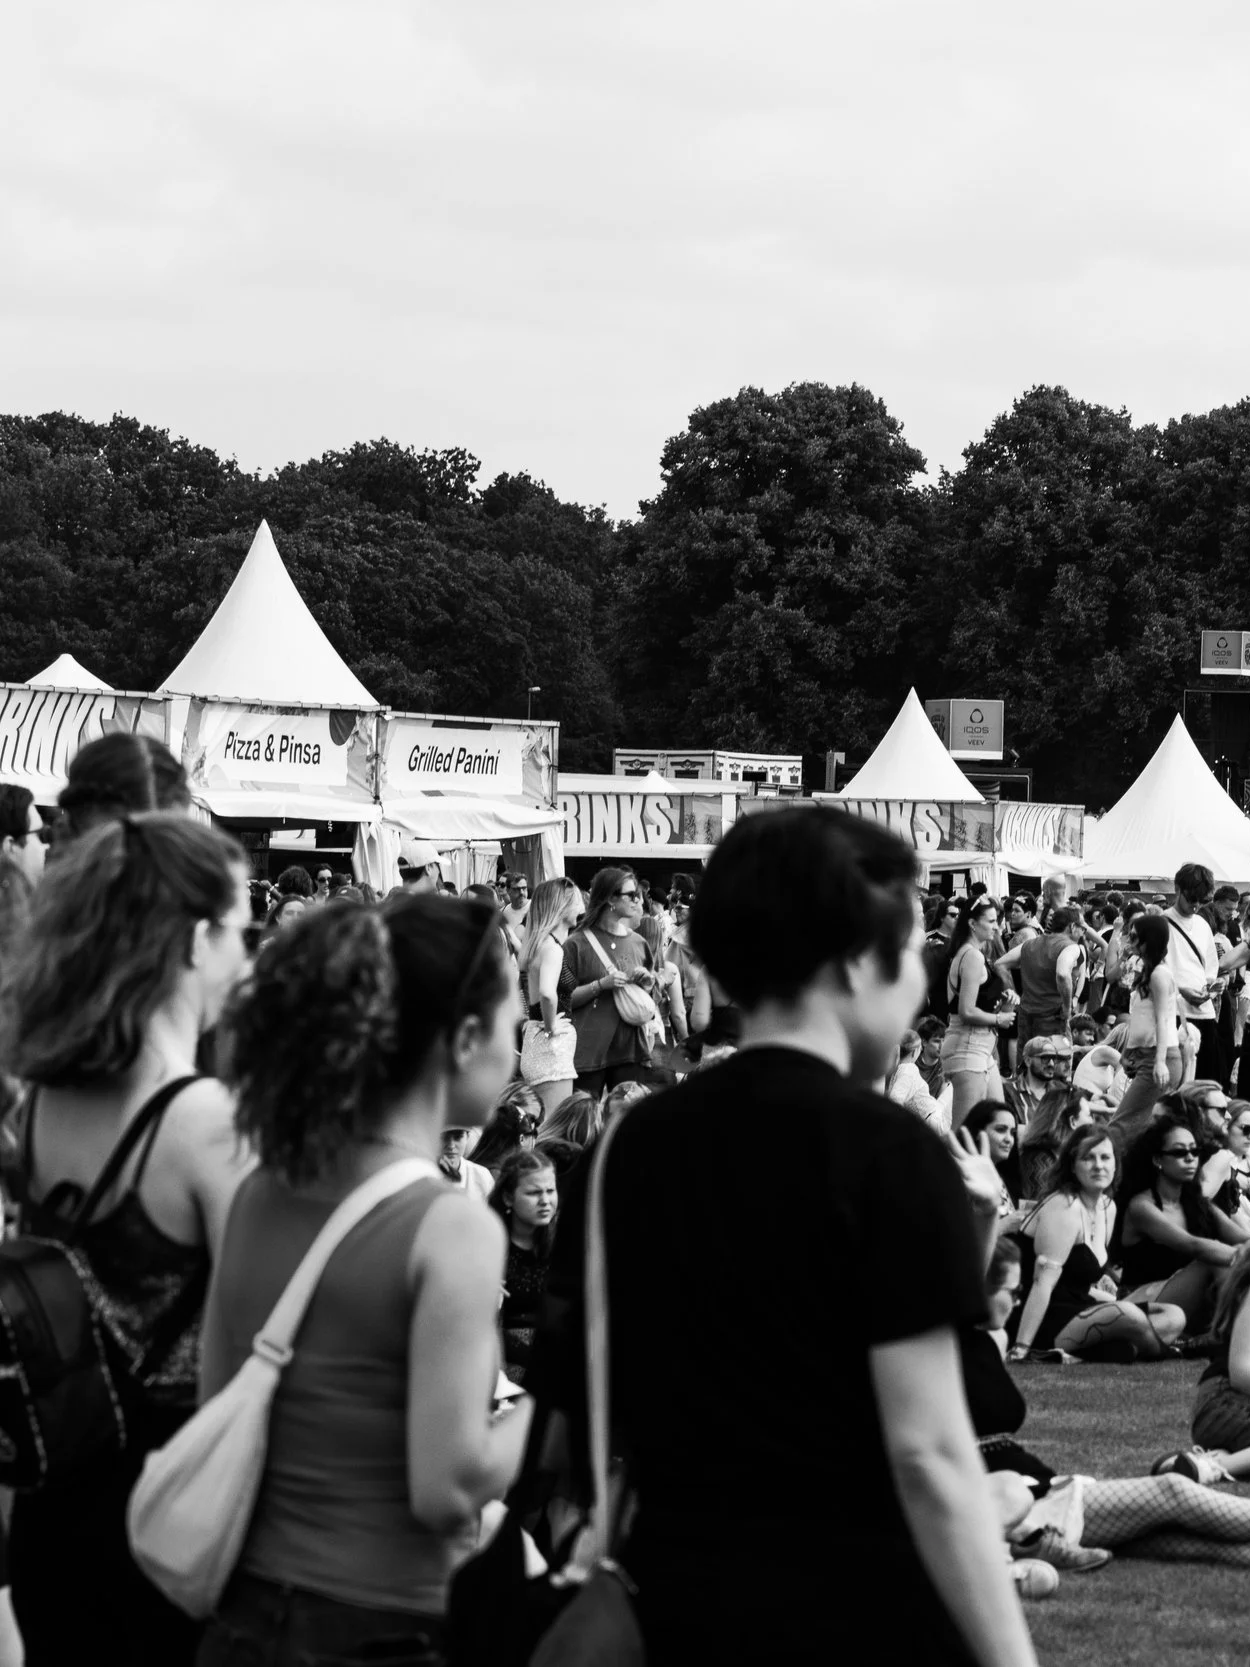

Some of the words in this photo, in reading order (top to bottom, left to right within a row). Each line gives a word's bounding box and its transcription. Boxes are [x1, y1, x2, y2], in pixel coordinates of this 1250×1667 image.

[0, 687, 118, 779] RINK
[963, 726, 989, 735] IQOS
[224, 731, 261, 762] Pizza
[265, 734, 275, 762] &
[279, 735, 321, 765] Pinsa
[408, 744, 453, 773] Grilled
[454, 747, 500, 775] Panini
[556, 794, 672, 843] RINKS
